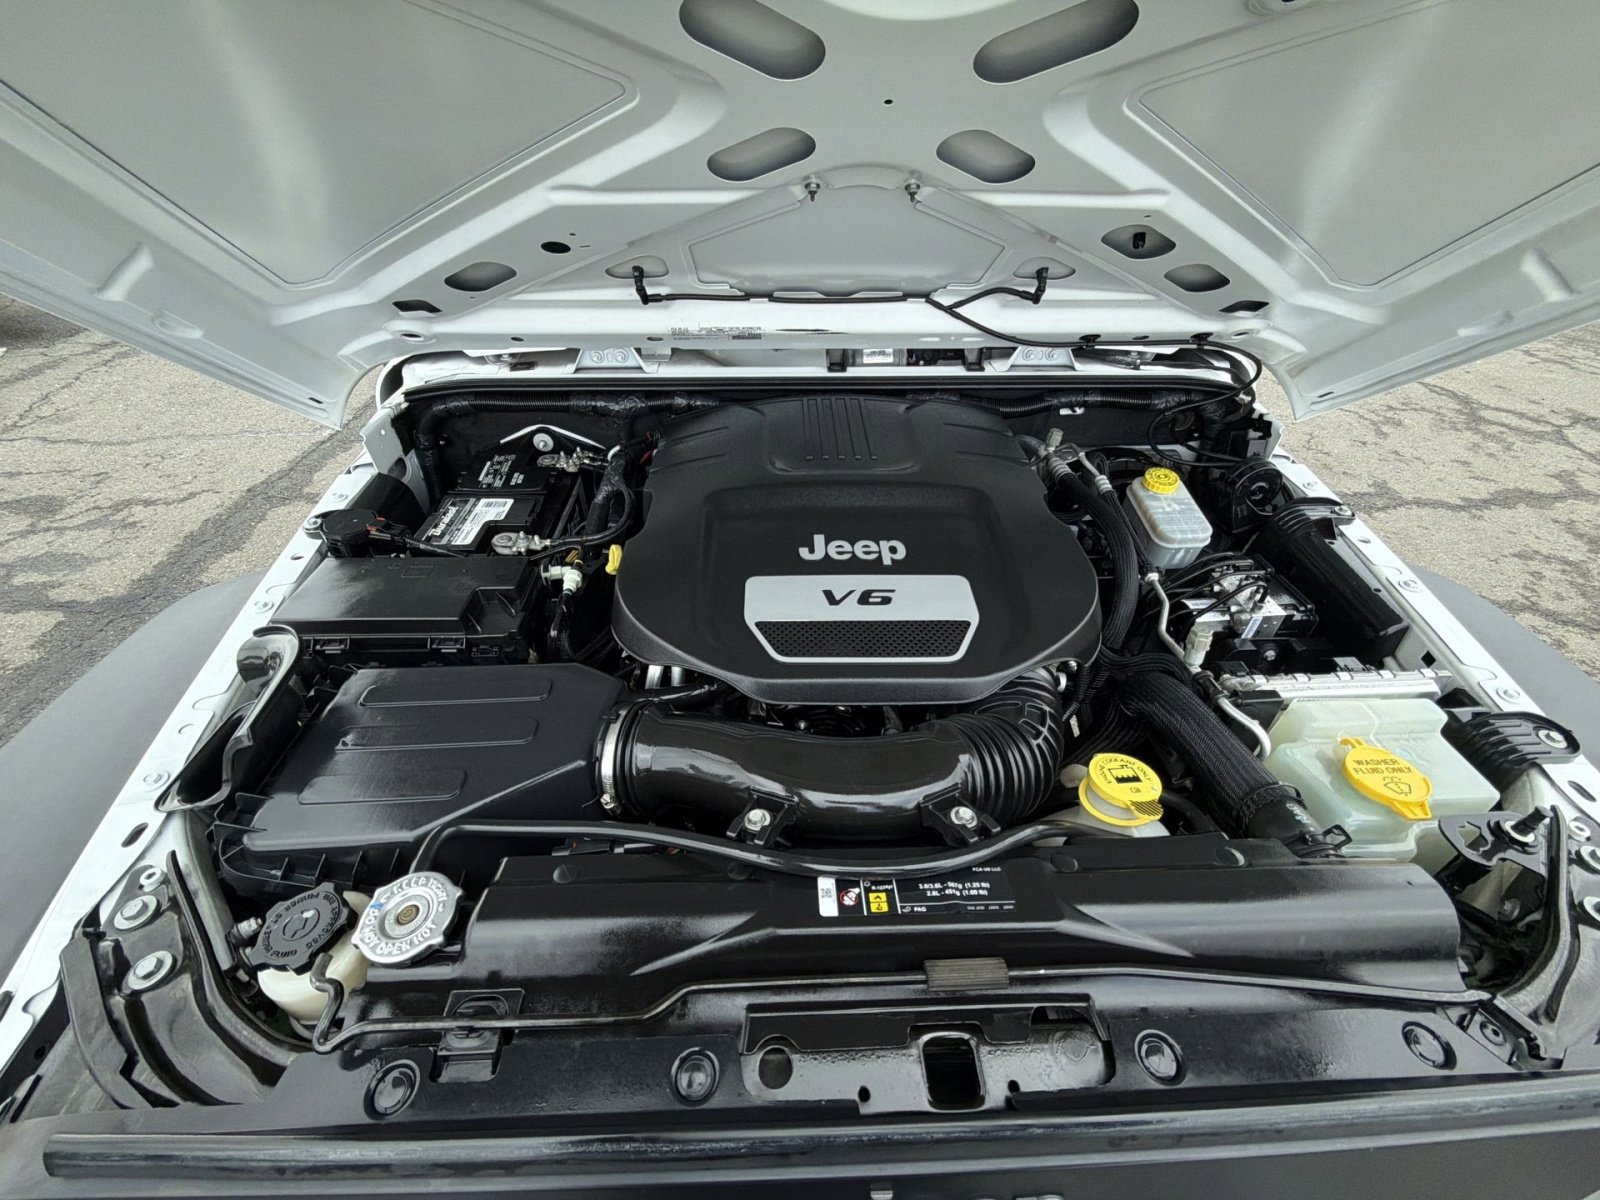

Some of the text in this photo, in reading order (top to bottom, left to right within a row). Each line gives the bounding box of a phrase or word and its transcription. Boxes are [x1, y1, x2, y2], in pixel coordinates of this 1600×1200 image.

[428, 506, 458, 536] Duralast
[798, 534, 907, 566] Jeep
[821, 589, 896, 606] V6
[1137, 766, 1152, 781] ONLY
[1353, 767, 1384, 775] FLUID
[361, 909, 437, 955] DO NOT OPEN HOT
